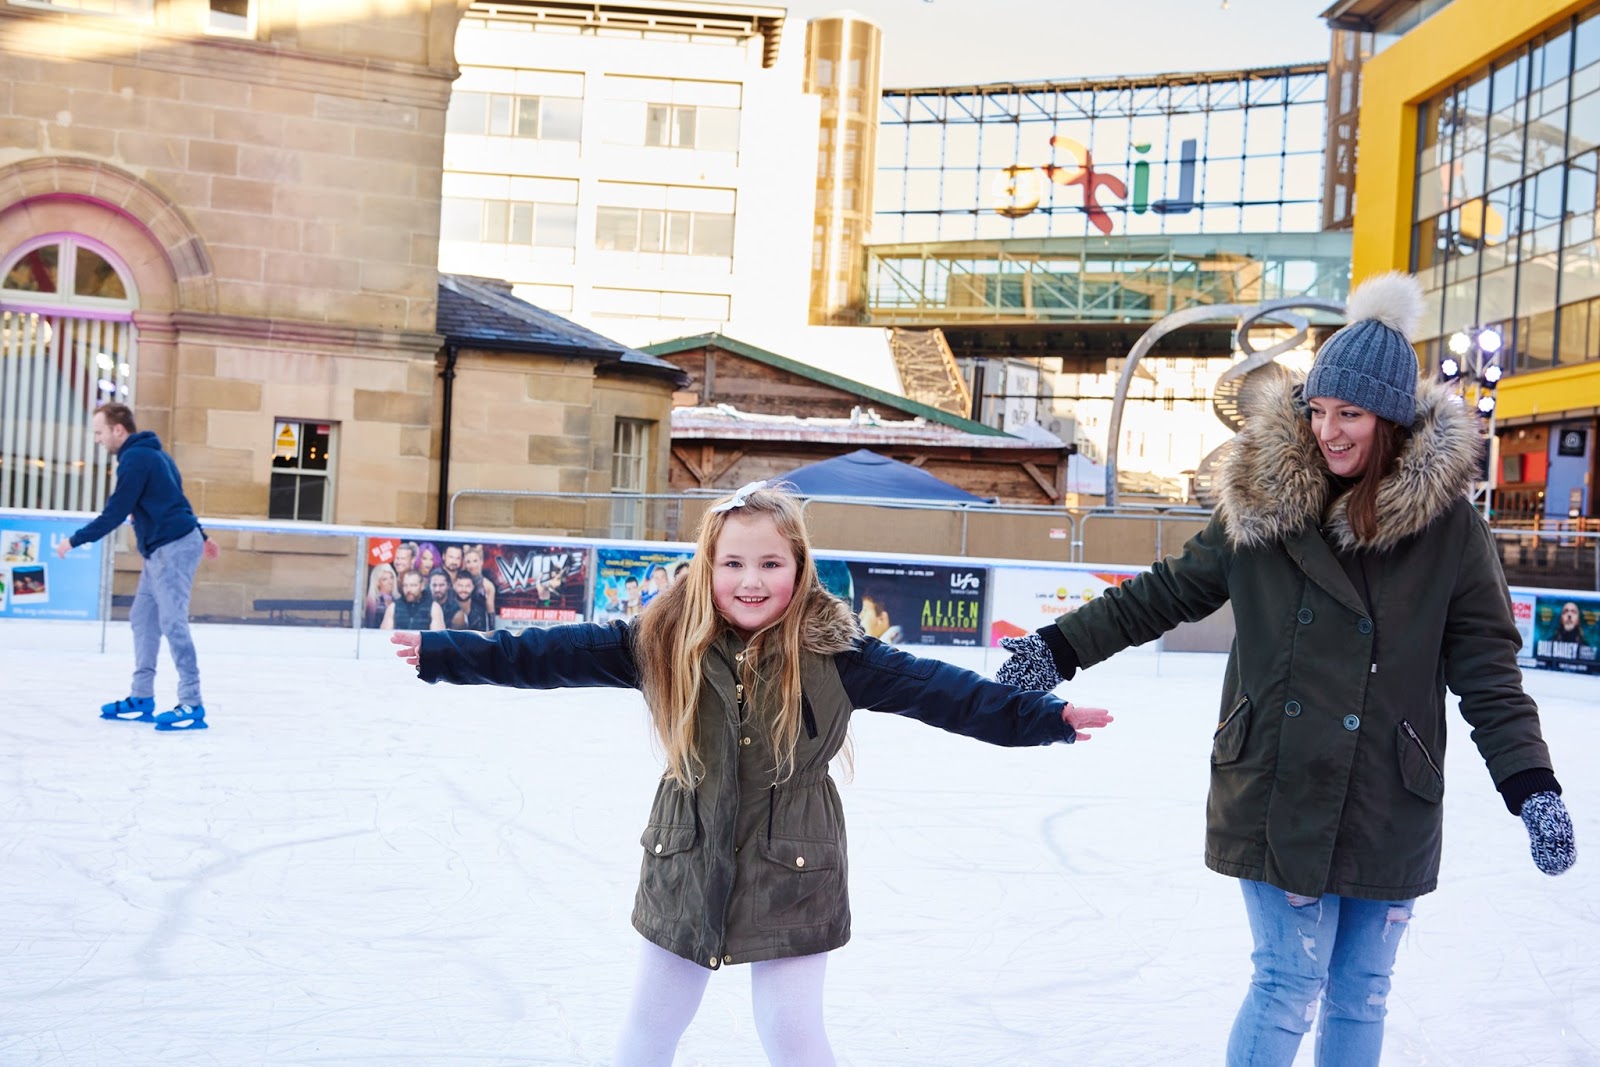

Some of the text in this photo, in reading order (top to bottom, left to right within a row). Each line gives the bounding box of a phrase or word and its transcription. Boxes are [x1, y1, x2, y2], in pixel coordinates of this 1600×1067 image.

[950, 573, 980, 590] Life
[921, 600, 979, 619] ALIEN
[921, 616, 979, 629] INVASION
